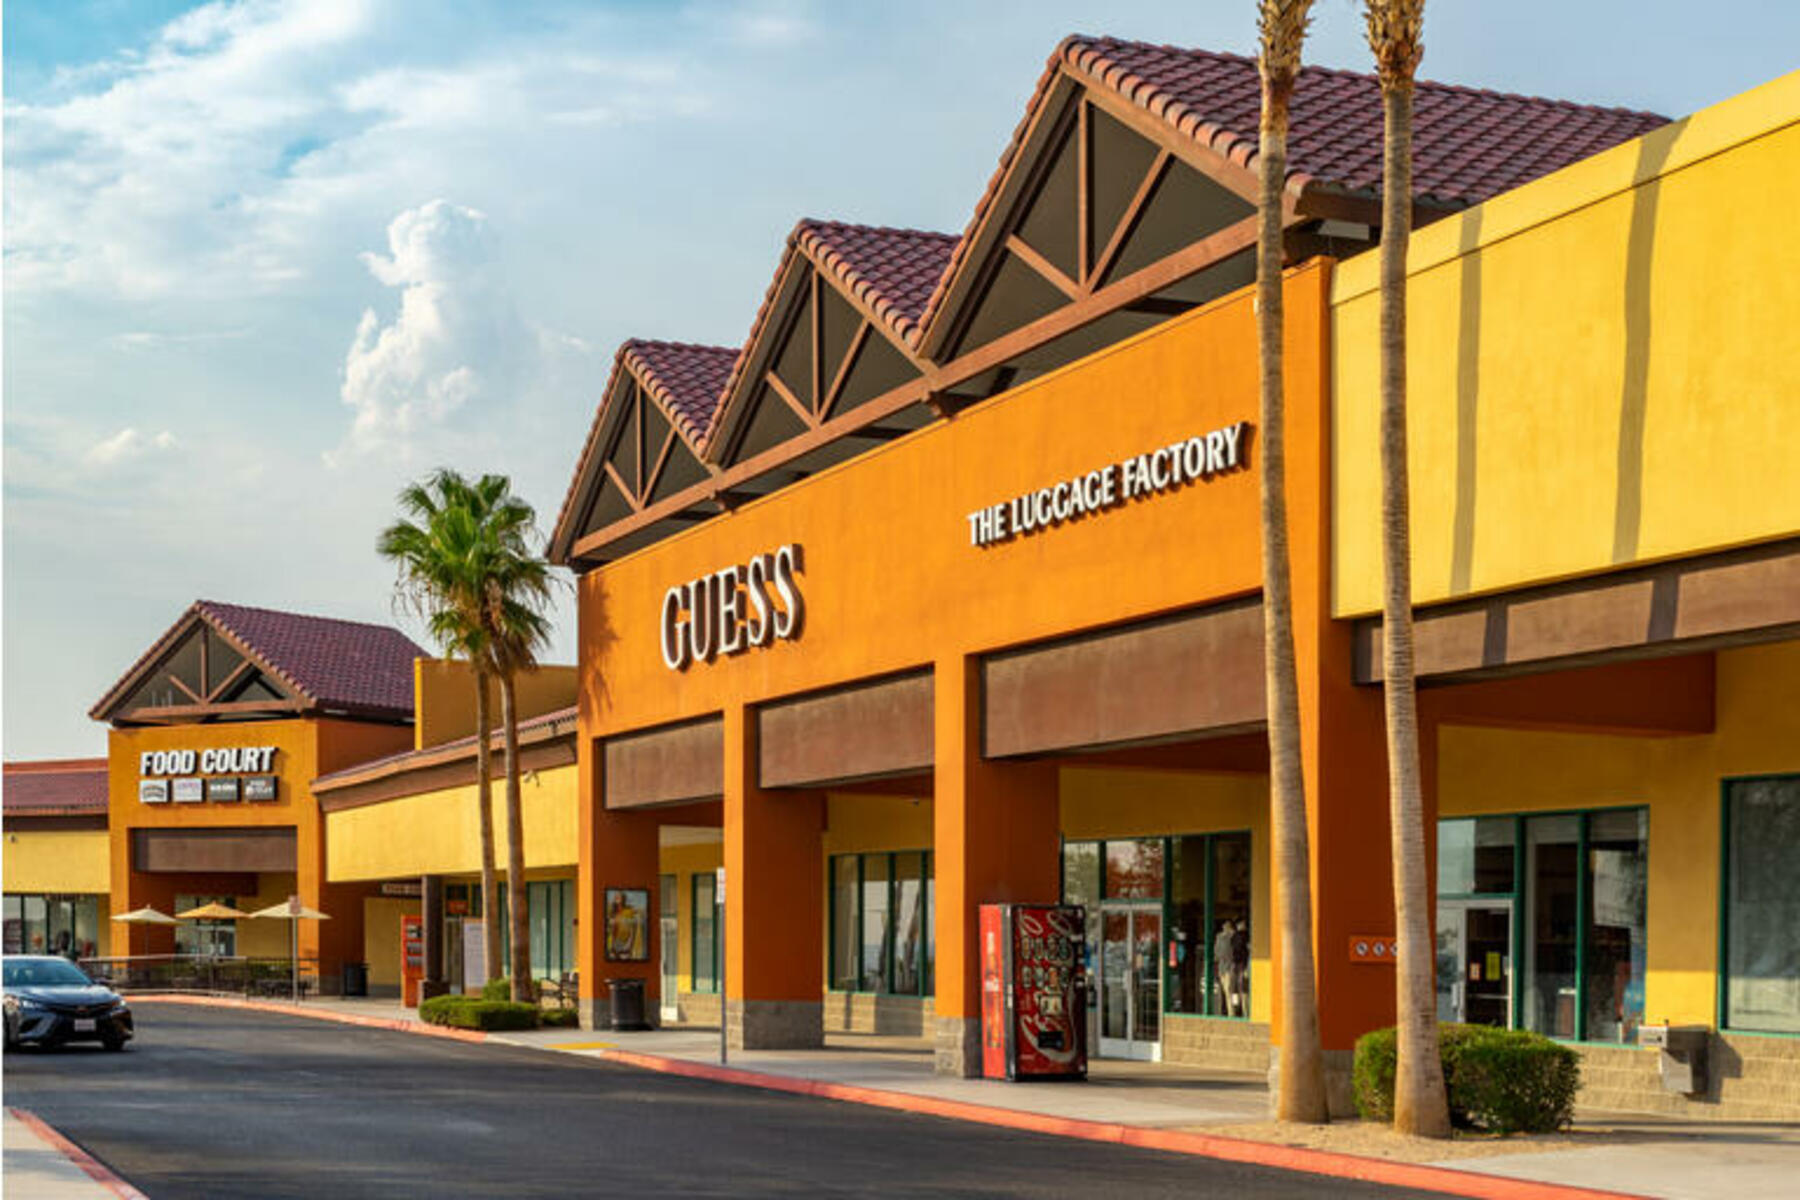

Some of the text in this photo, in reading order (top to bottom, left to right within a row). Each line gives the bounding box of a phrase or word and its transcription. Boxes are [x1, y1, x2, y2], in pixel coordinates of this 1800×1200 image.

[967, 421, 1244, 545] THE LUGGAGE FACTORY
[660, 543, 798, 670] GUESS
[140, 746, 276, 775] FOOD COURT
